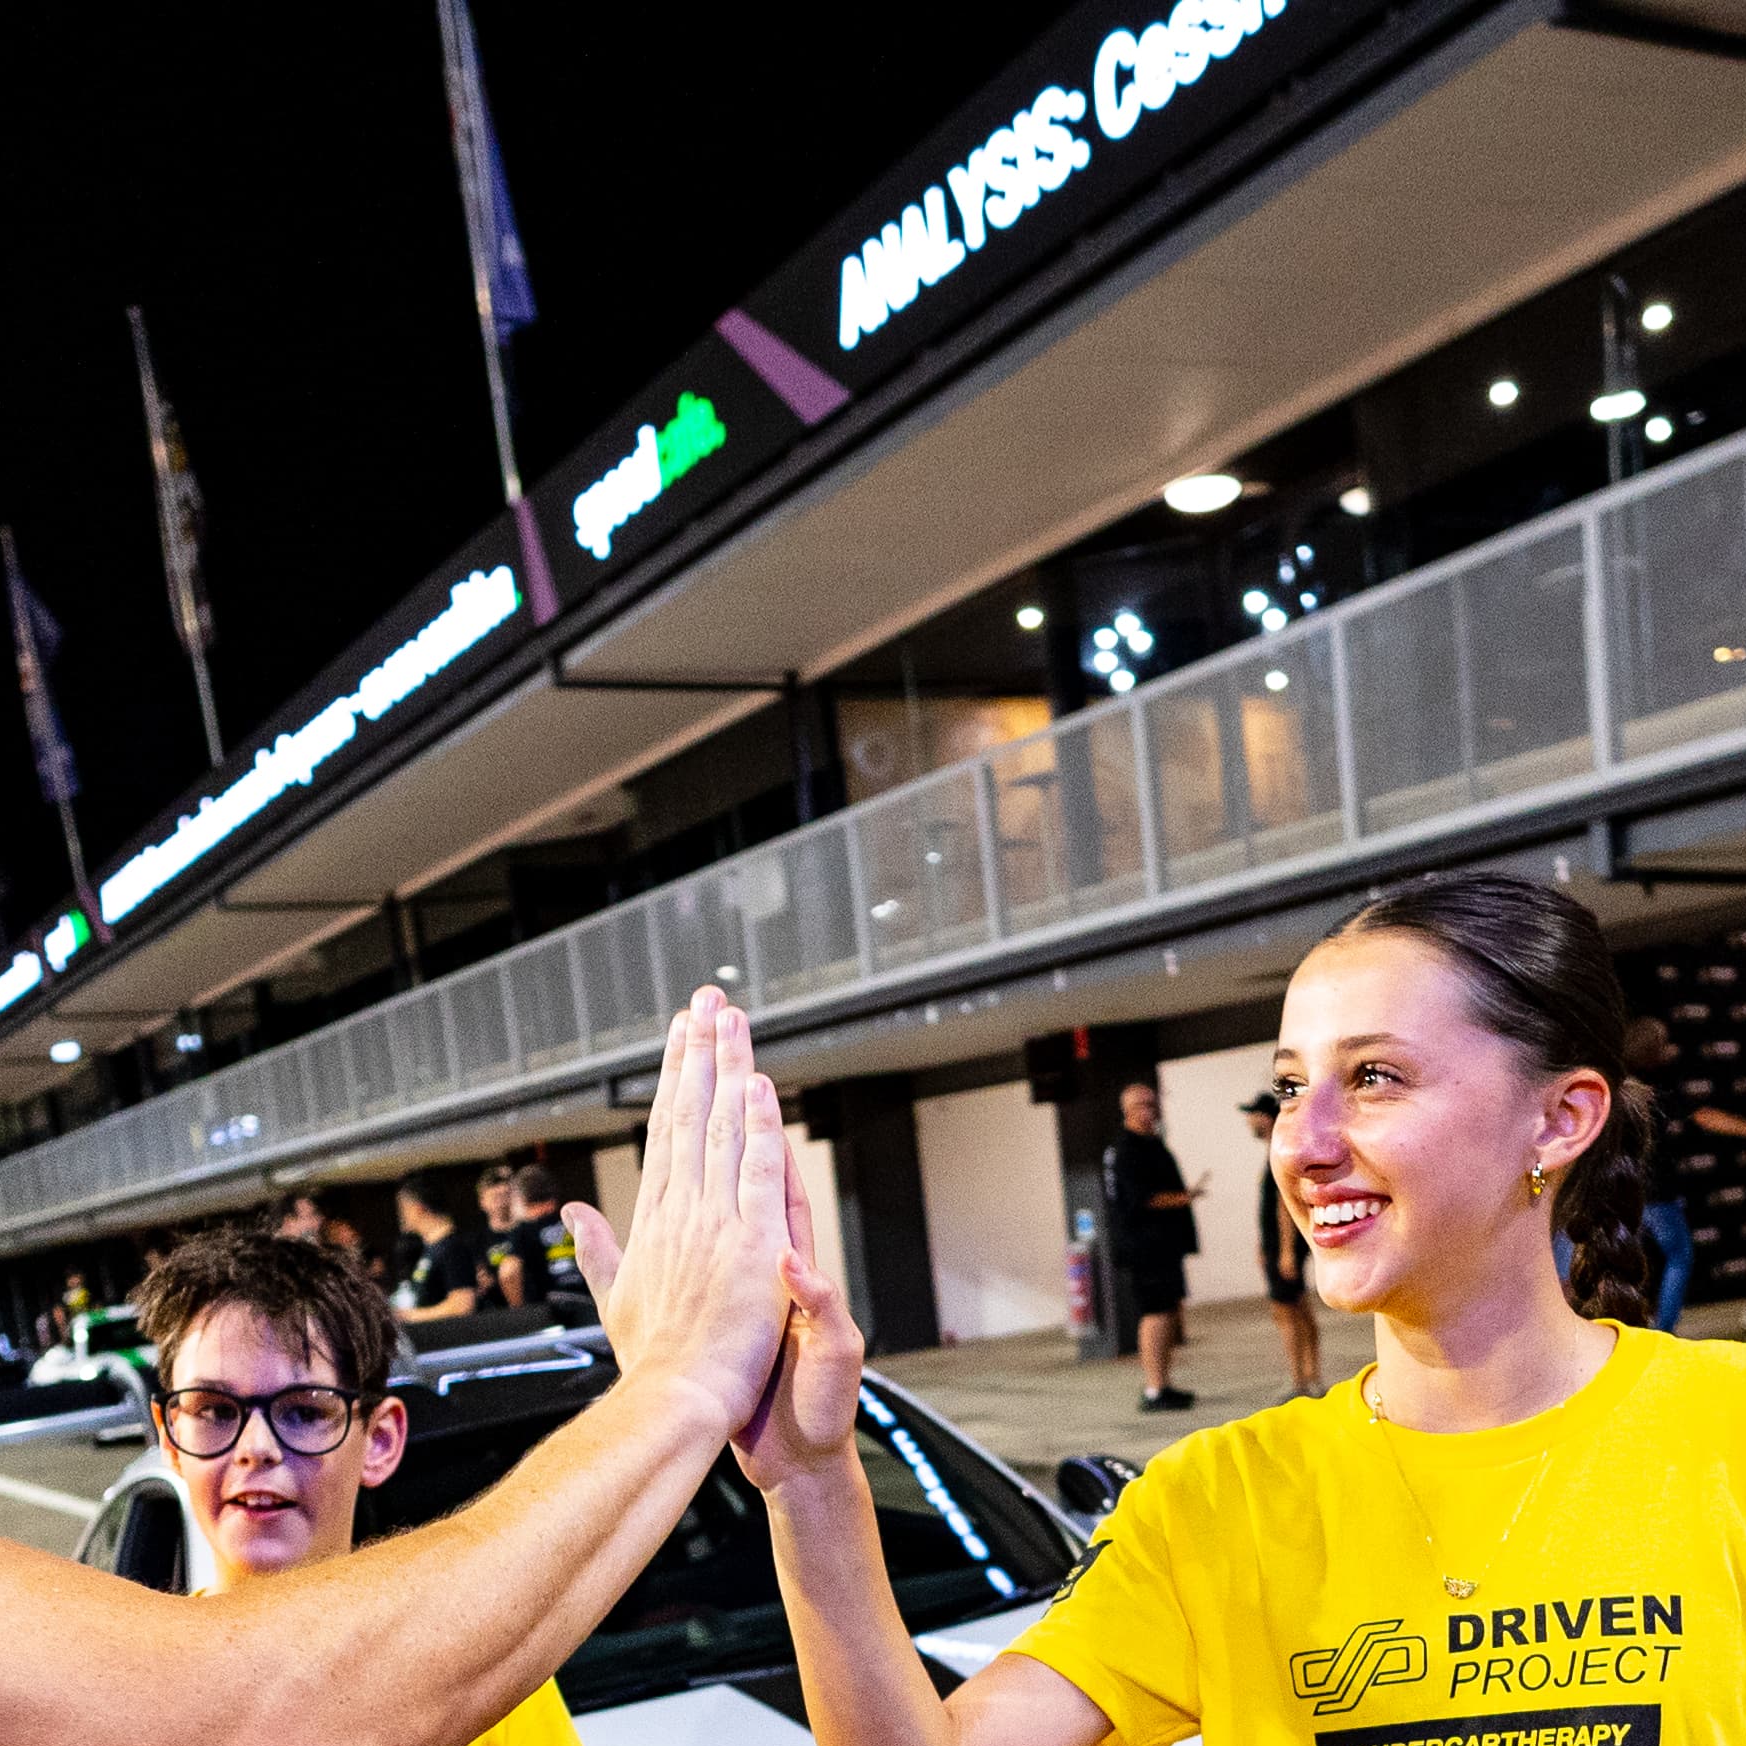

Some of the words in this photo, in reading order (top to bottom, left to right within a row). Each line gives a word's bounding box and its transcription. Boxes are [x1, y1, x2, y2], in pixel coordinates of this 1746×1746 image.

[839, 86, 1091, 350] ANALYSIS:
[1448, 1594, 1683, 1653] DRIVEN
[1449, 1646, 1681, 1698] PROJECT
